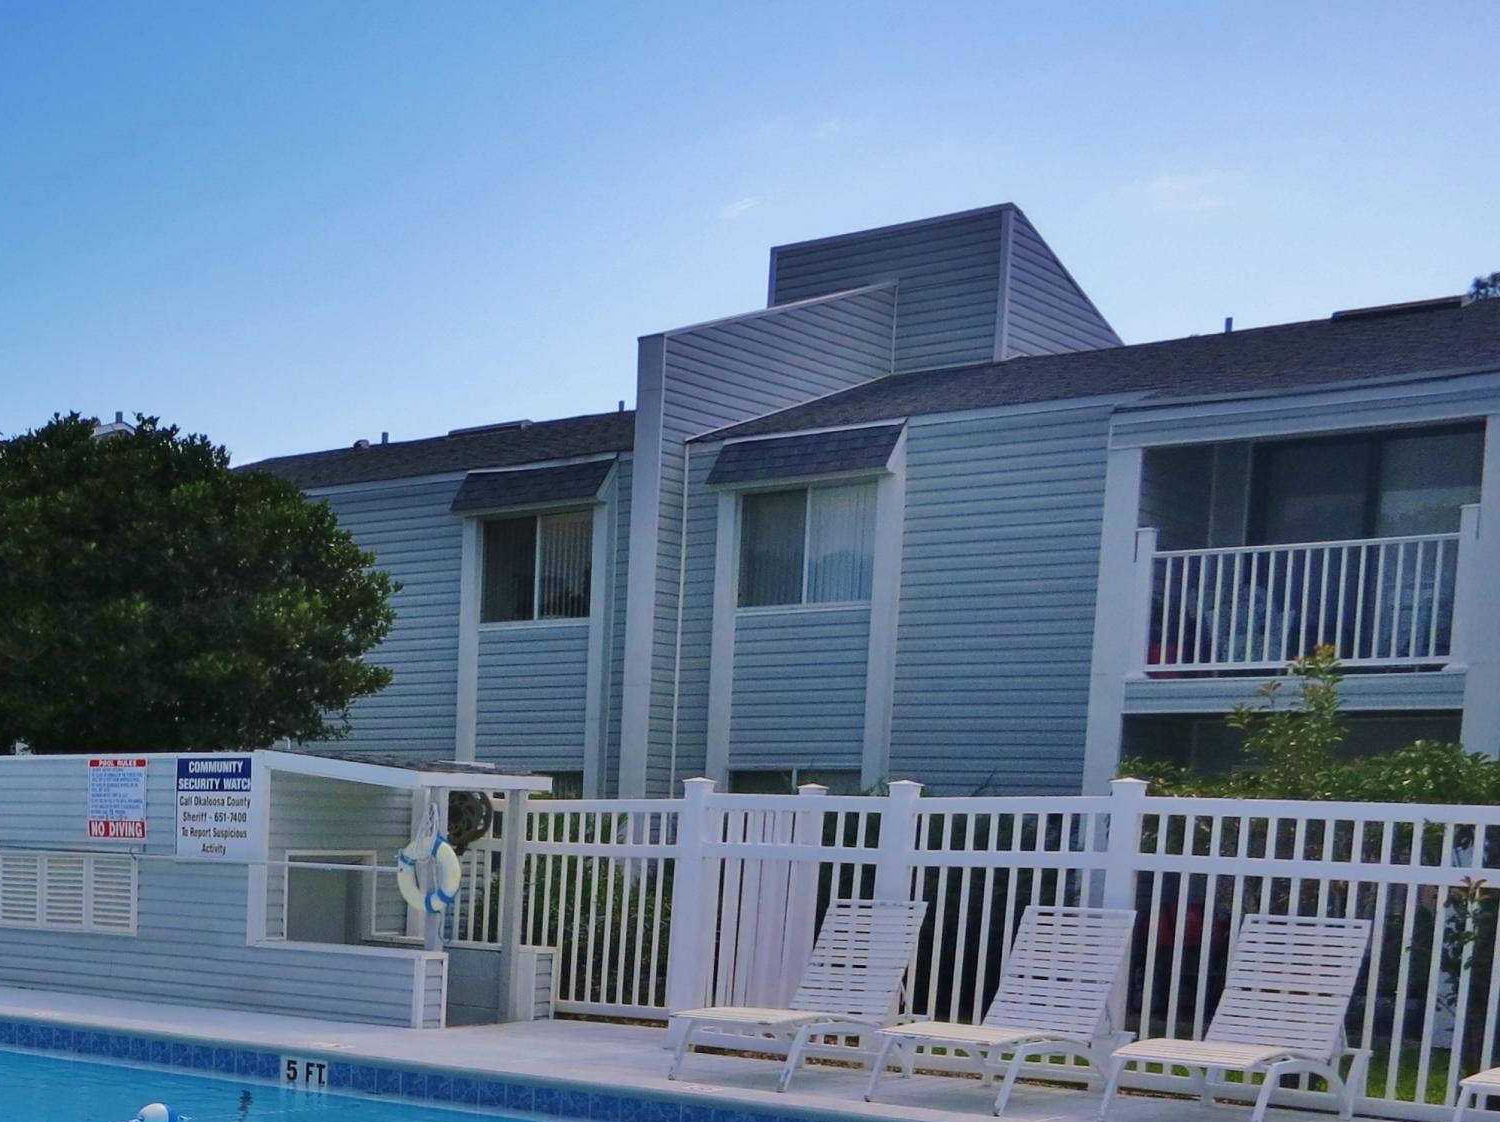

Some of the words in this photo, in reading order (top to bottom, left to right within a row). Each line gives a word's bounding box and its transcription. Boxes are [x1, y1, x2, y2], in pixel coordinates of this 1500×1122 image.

[188, 761, 243, 773] COMMUNITY
[178, 778, 220, 790] SECURITY
[180, 796, 192, 806] Call
[194, 796, 225, 806] Okaloosa
[227, 796, 251, 808] County
[183, 812, 207, 822] Sheriff
[214, 812, 247, 822] 651-7400
[91, 821, 105, 836] NO
[109, 821, 143, 837] DIVING
[182, 827, 189, 837] To
[190, 827, 211, 839] Report
[213, 827, 247, 840] Suspicious
[202, 843, 227, 855] Activity
[286, 1060, 298, 1081] 5
